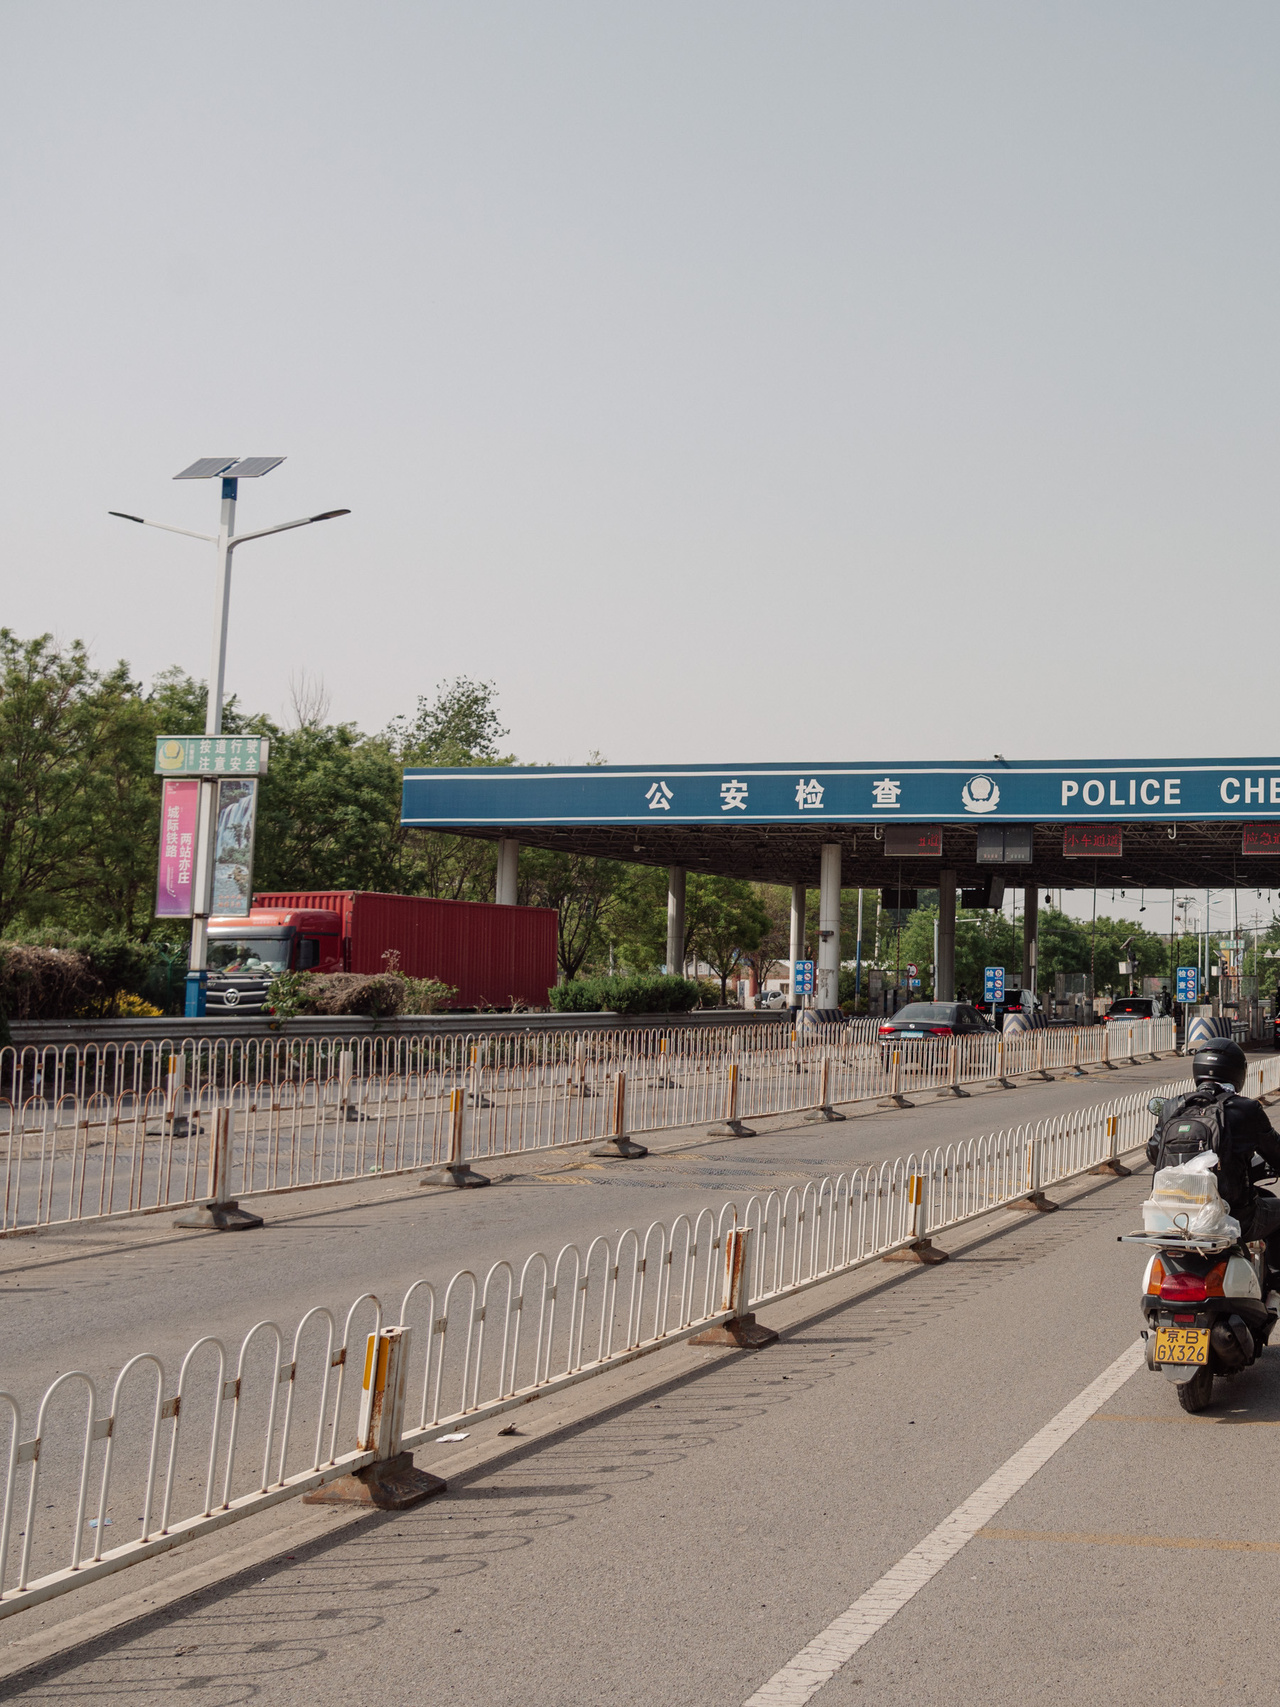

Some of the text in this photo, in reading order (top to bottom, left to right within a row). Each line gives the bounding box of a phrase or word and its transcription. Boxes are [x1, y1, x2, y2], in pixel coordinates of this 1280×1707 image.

[200, 739, 258, 754] 按道行驶
[199, 756, 257, 771] 注意安全
[645, 778, 902, 811] 公安检查
[1061, 778, 1181, 806] POLICE
[165, 805, 180, 858] 城际铁路
[1067, 833, 1121, 848] 小车通道
[177, 832, 193, 884] 两站亦庄
[1178, 969, 1187, 1000] 检查区
[1157, 1345, 1205, 1361] GX326
